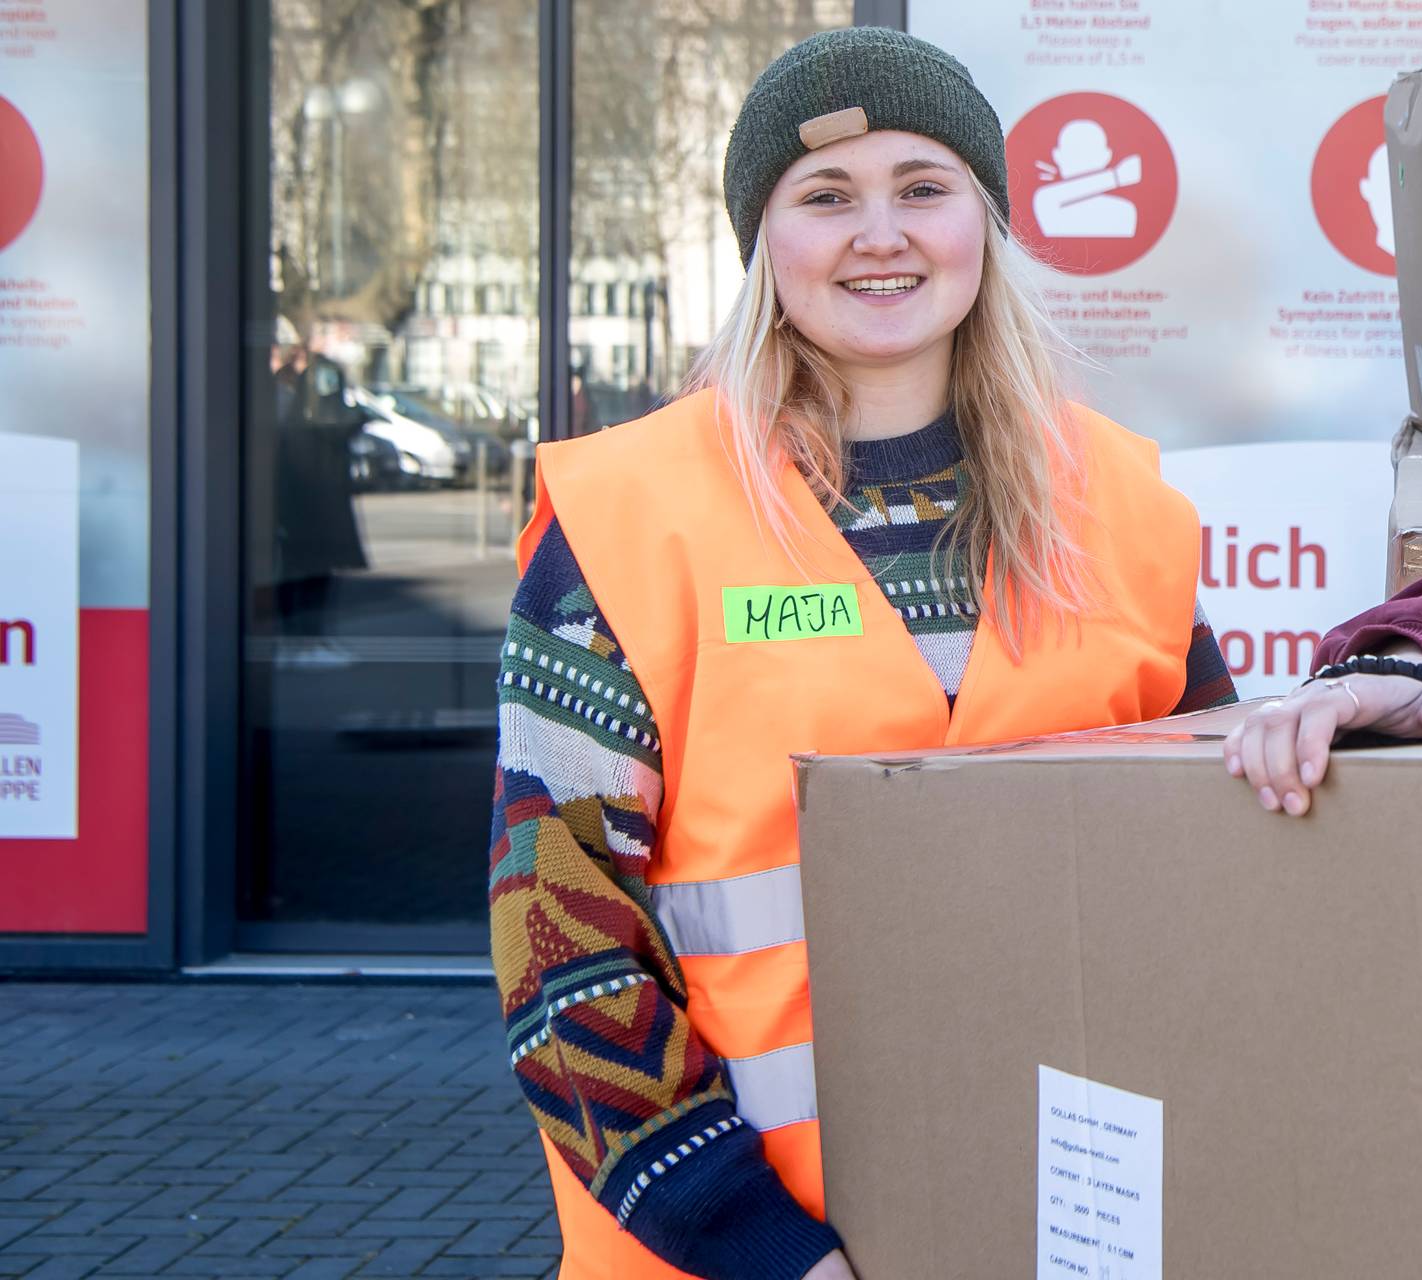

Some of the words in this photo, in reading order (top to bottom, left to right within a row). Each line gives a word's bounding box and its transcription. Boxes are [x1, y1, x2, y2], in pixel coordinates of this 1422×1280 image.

[1046, 16, 1086, 28] Meter
[1092, 15, 1150, 28] Abstand
[746, 594, 851, 639] MAJA
